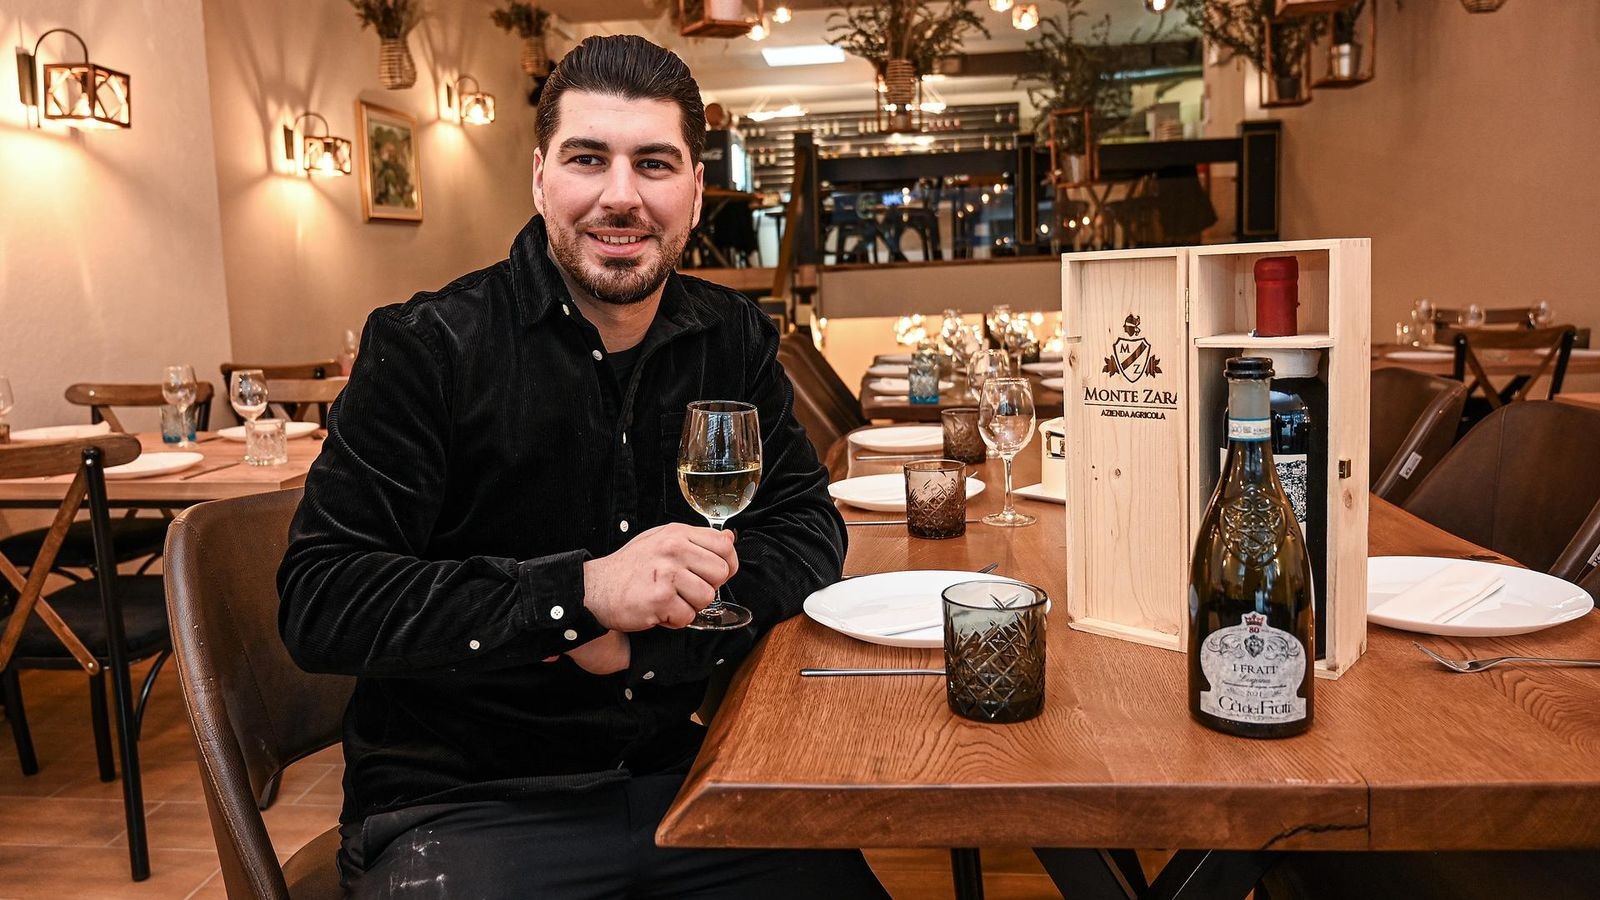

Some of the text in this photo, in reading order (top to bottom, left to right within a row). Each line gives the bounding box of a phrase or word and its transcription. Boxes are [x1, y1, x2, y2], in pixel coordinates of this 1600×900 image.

[1120, 344, 1130, 353] M
[1133, 364, 1141, 374] Z
[1084, 387, 1139, 403] MONTE
[1101, 409, 1166, 420] AZIENDA AGRICOLA
